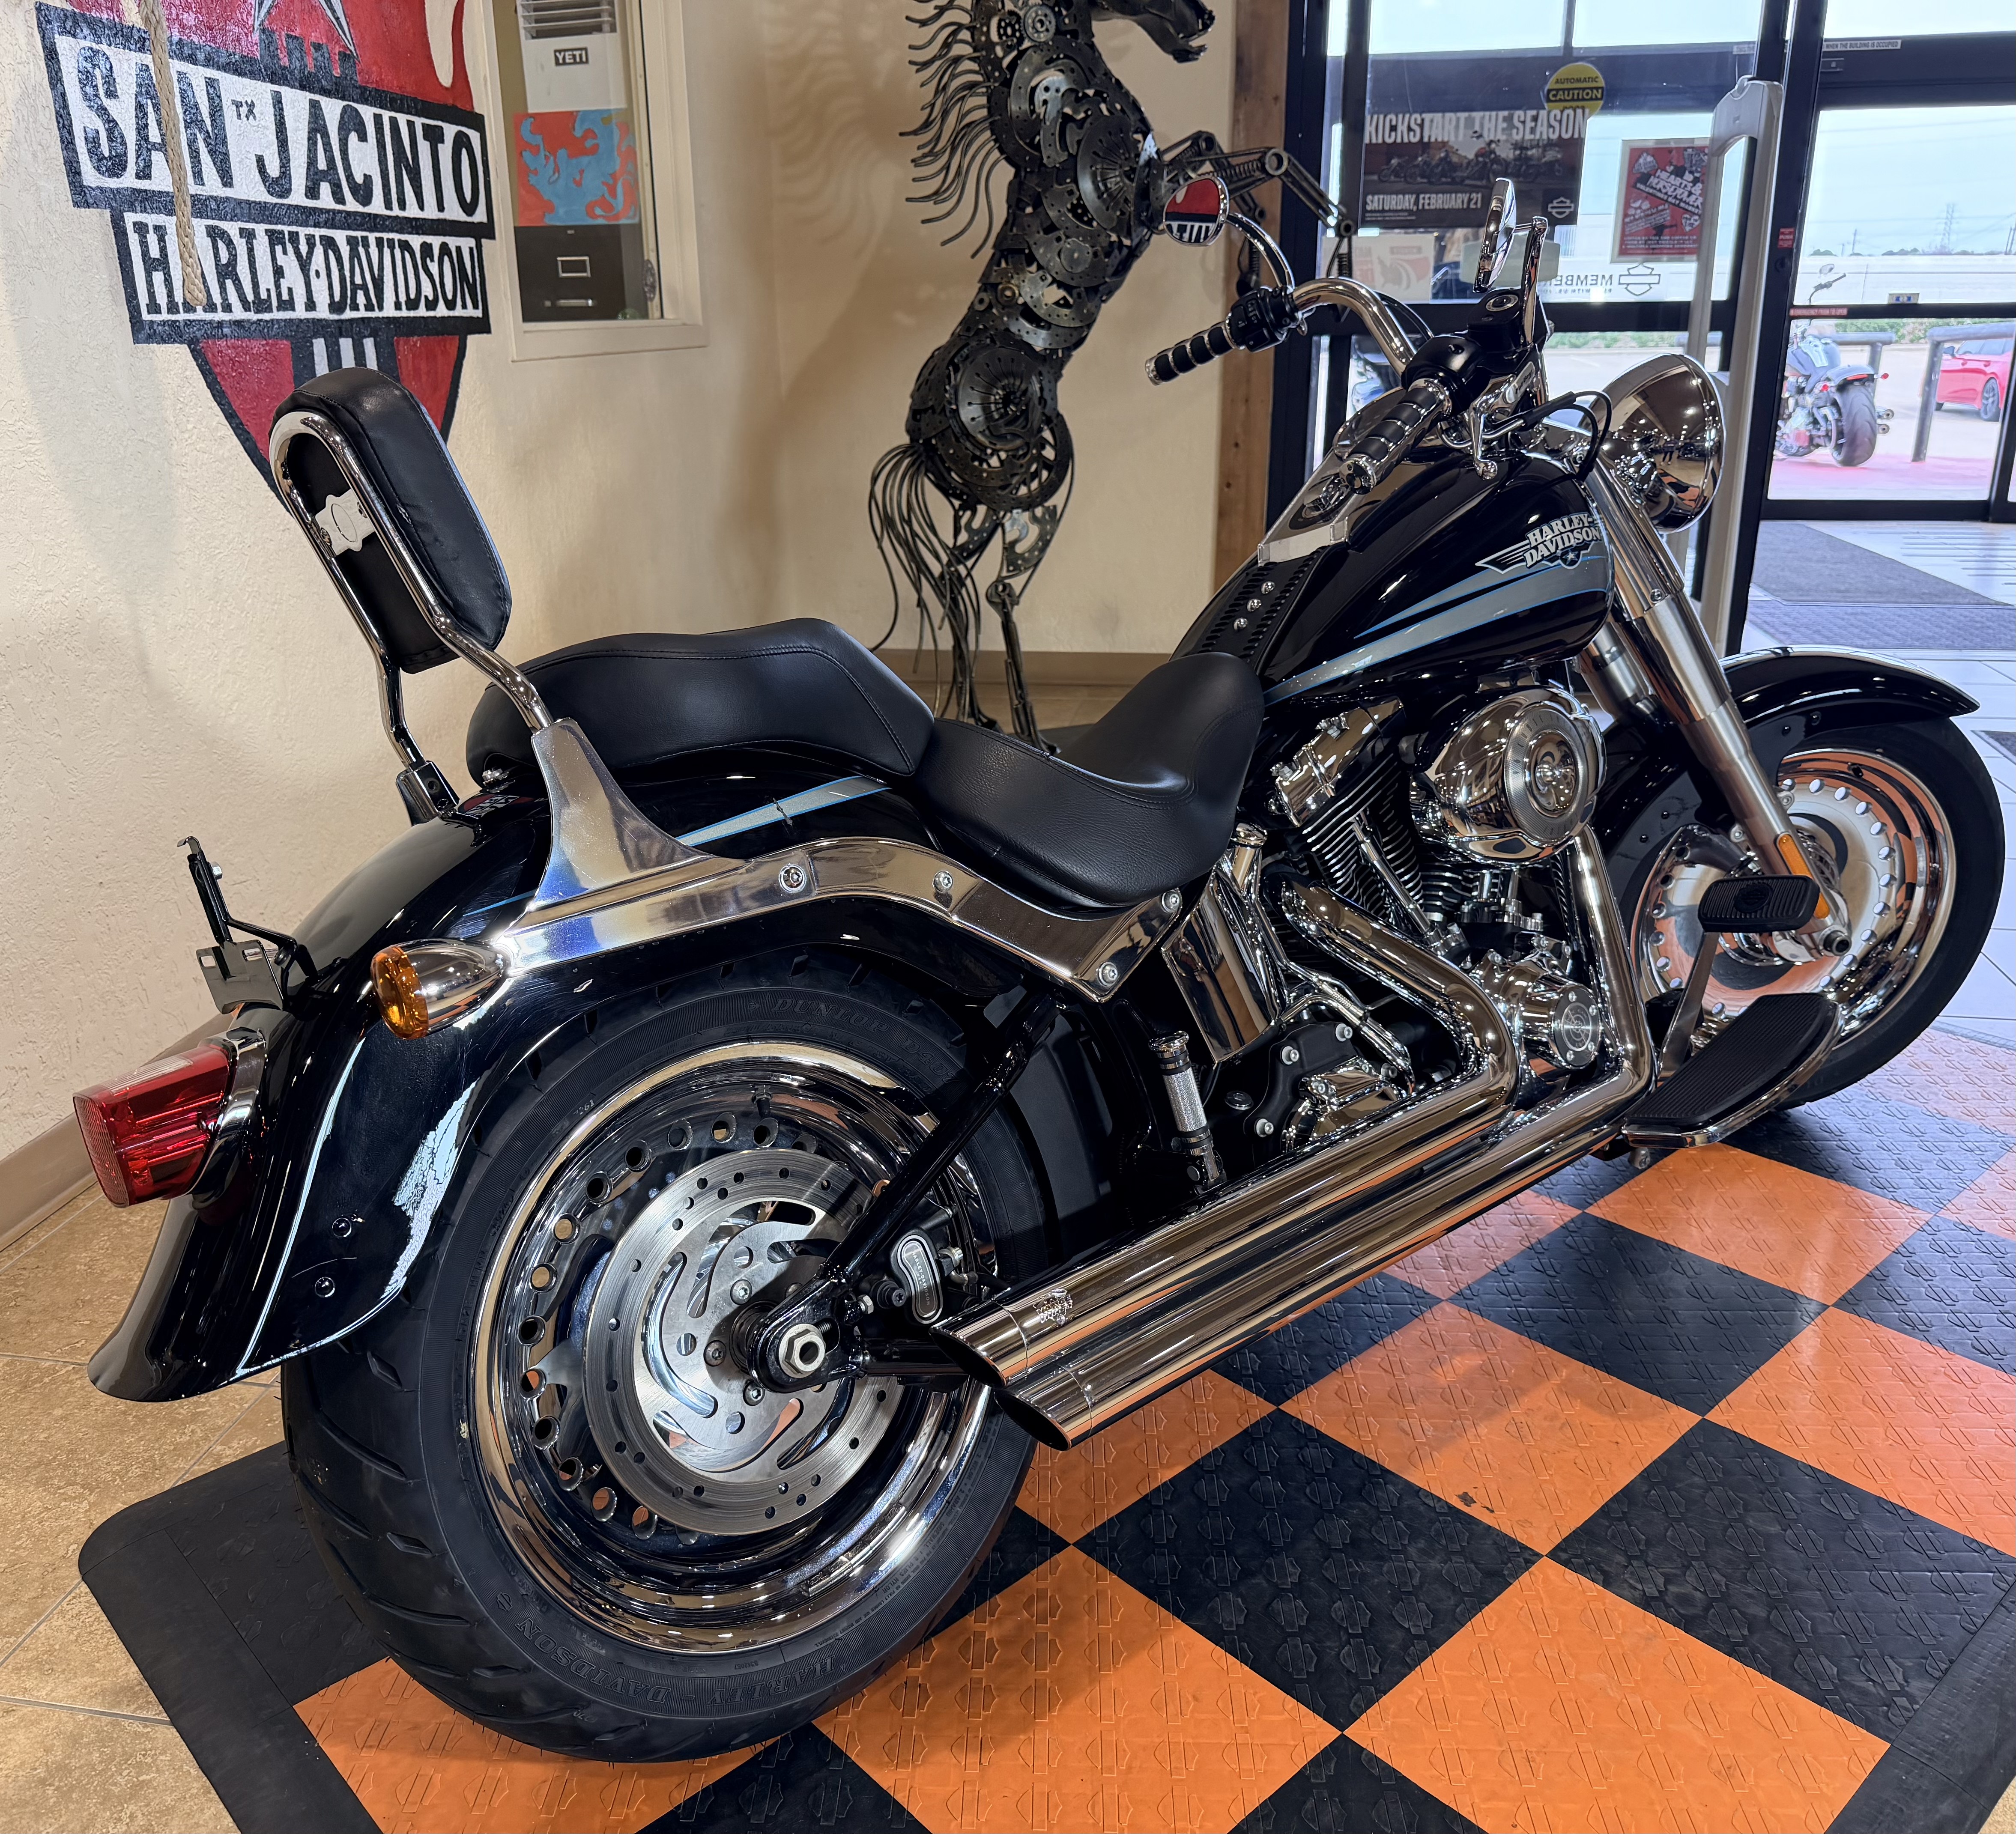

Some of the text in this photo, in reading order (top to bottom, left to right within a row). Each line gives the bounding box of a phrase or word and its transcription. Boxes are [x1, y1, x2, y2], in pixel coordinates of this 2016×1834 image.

[556, 50, 587, 63] YETI
[1548, 88, 1603, 101] CAUTION
[1554, 76, 1598, 85] AUTOMATIC
[77, 46, 233, 188] SAN
[256, 91, 480, 217] JACINTO
[1365, 109, 1590, 144] KICKSTART THE SEASON
[1366, 192, 1482, 212] SATURDAY, FEBRUARY 21
[1523, 526, 1602, 568] DAVIDSON
[1527, 513, 1593, 547] HARLEY-
[771, 998, 890, 1033] DUNLOP
[923, 1520, 945, 1550] SIDEWALL
[881, 1576, 899, 1594] NYLON
[513, 1617, 671, 1703] DAVIDSON
[705, 1655, 835, 1706] HARLEY
